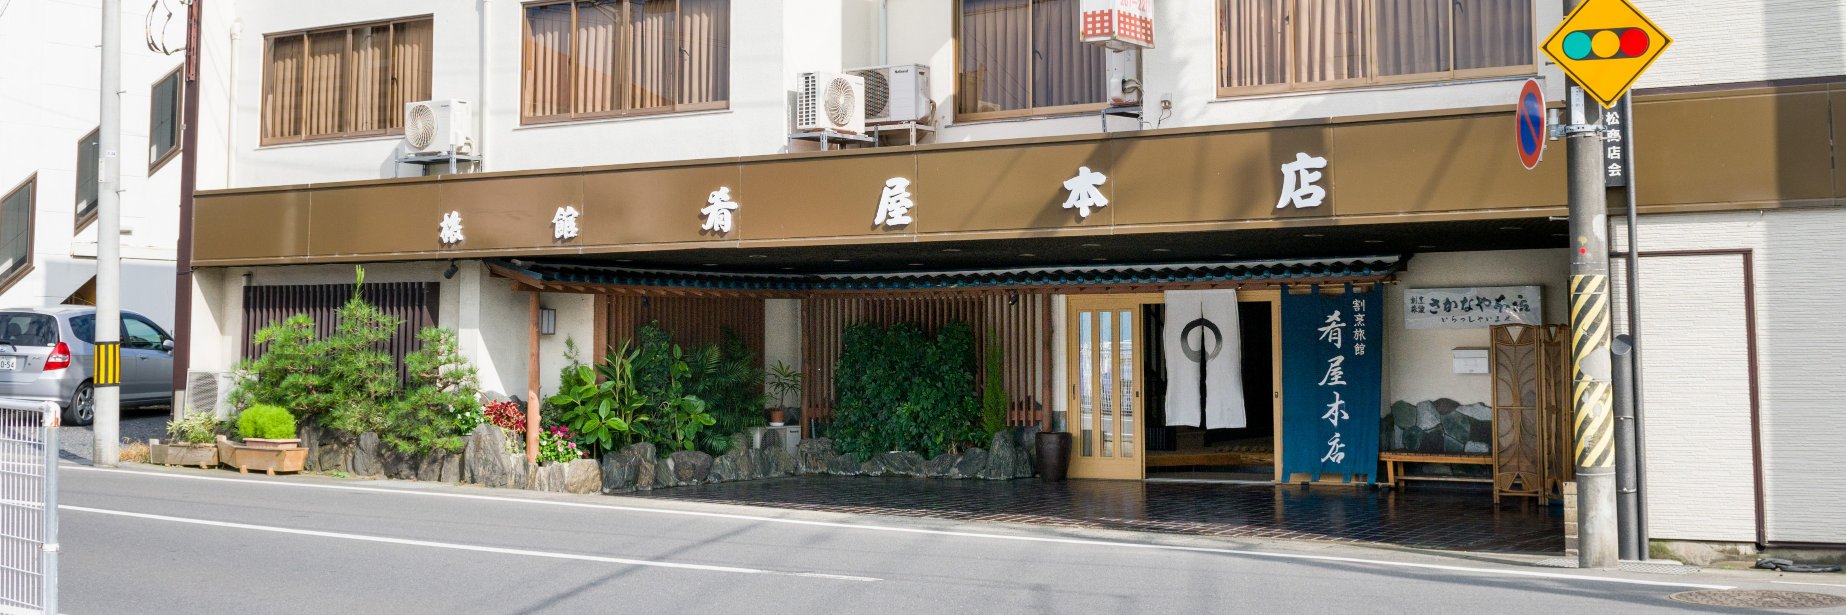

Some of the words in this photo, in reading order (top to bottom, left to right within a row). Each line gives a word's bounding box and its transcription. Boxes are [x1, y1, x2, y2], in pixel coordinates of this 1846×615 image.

[1605, 101, 1621, 176] 松商店会
[1352, 299, 1366, 356] 割烹旅館
[1317, 310, 1349, 464] 肴屋本店
